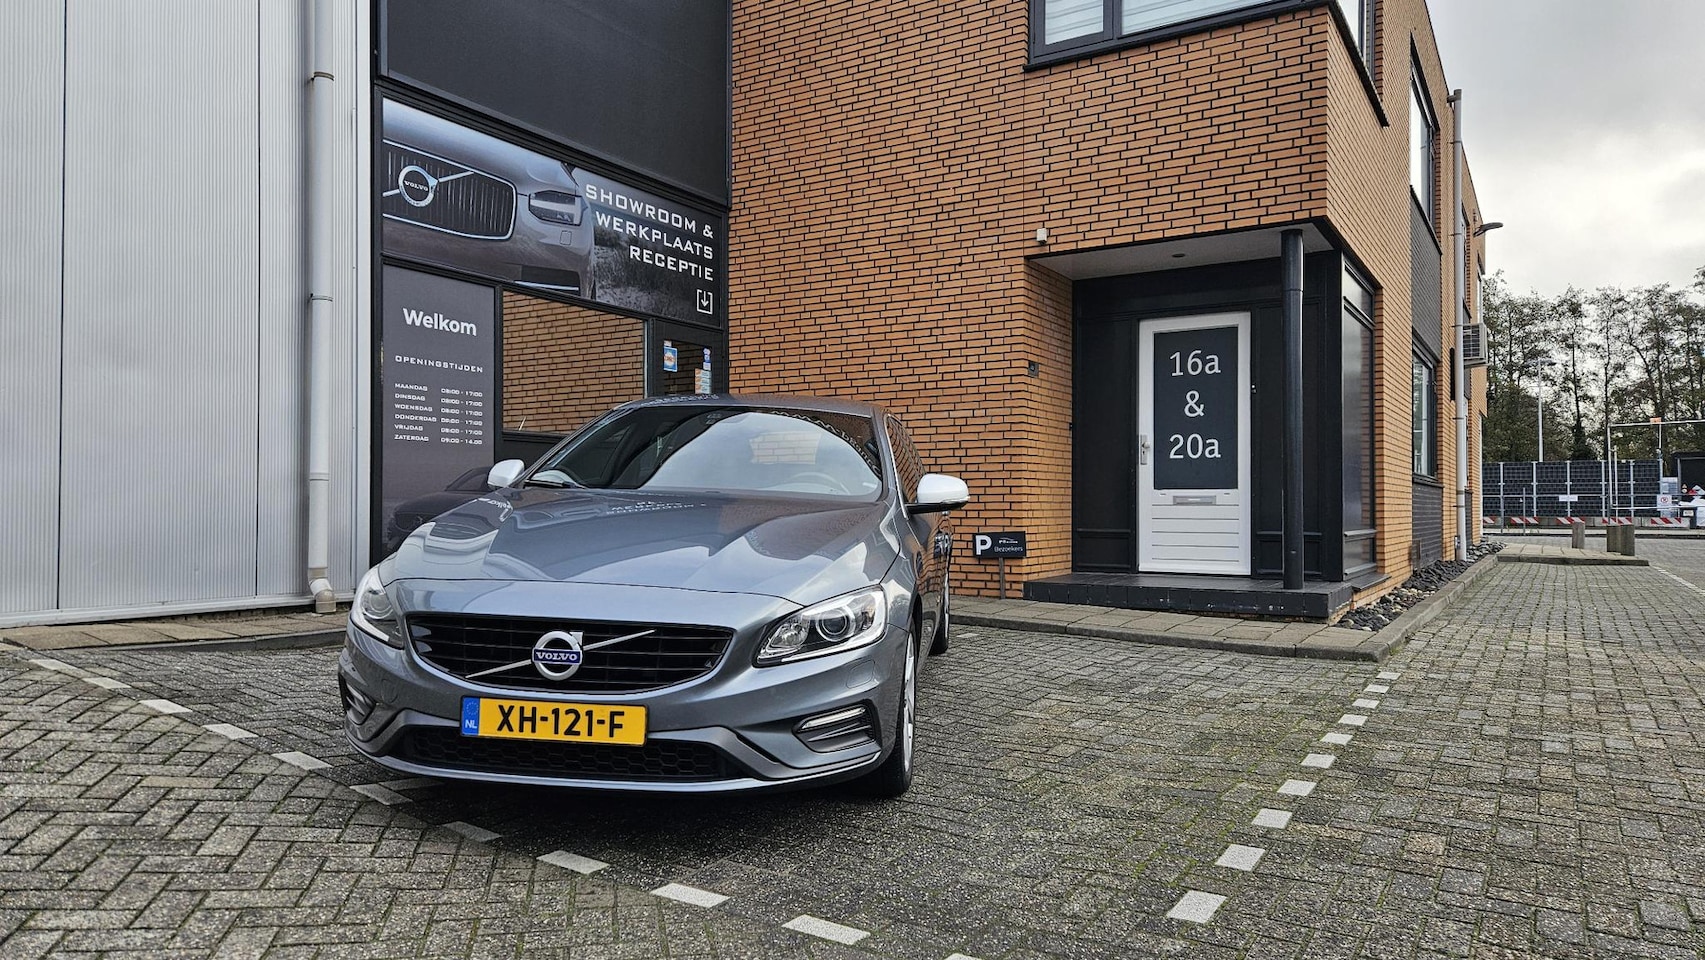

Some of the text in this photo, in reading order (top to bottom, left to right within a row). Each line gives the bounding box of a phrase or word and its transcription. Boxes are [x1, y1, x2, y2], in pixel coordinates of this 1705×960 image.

[404, 180, 429, 192] VOLVO
[586, 184, 714, 239] SHOWROOM &
[595, 211, 713, 260] WERKPLAATS
[629, 245, 713, 281] RECEPTIE
[402, 307, 477, 337] Welkom
[394, 355, 483, 373] OPENINGSTIJDEN
[1169, 350, 1221, 377] 16a
[394, 382, 428, 392] MAANDAG
[394, 393, 426, 401] DINSDAG
[394, 403, 433, 412] WOENSDAG
[1184, 390, 1205, 417] &
[394, 414, 437, 422] DONDERDAG
[1169, 433, 1221, 459] 20a
[975, 535, 992, 555] P
[535, 651, 578, 662] VOLVO
[465, 719, 478, 729] NL
[497, 704, 625, 738] XH-121-F
